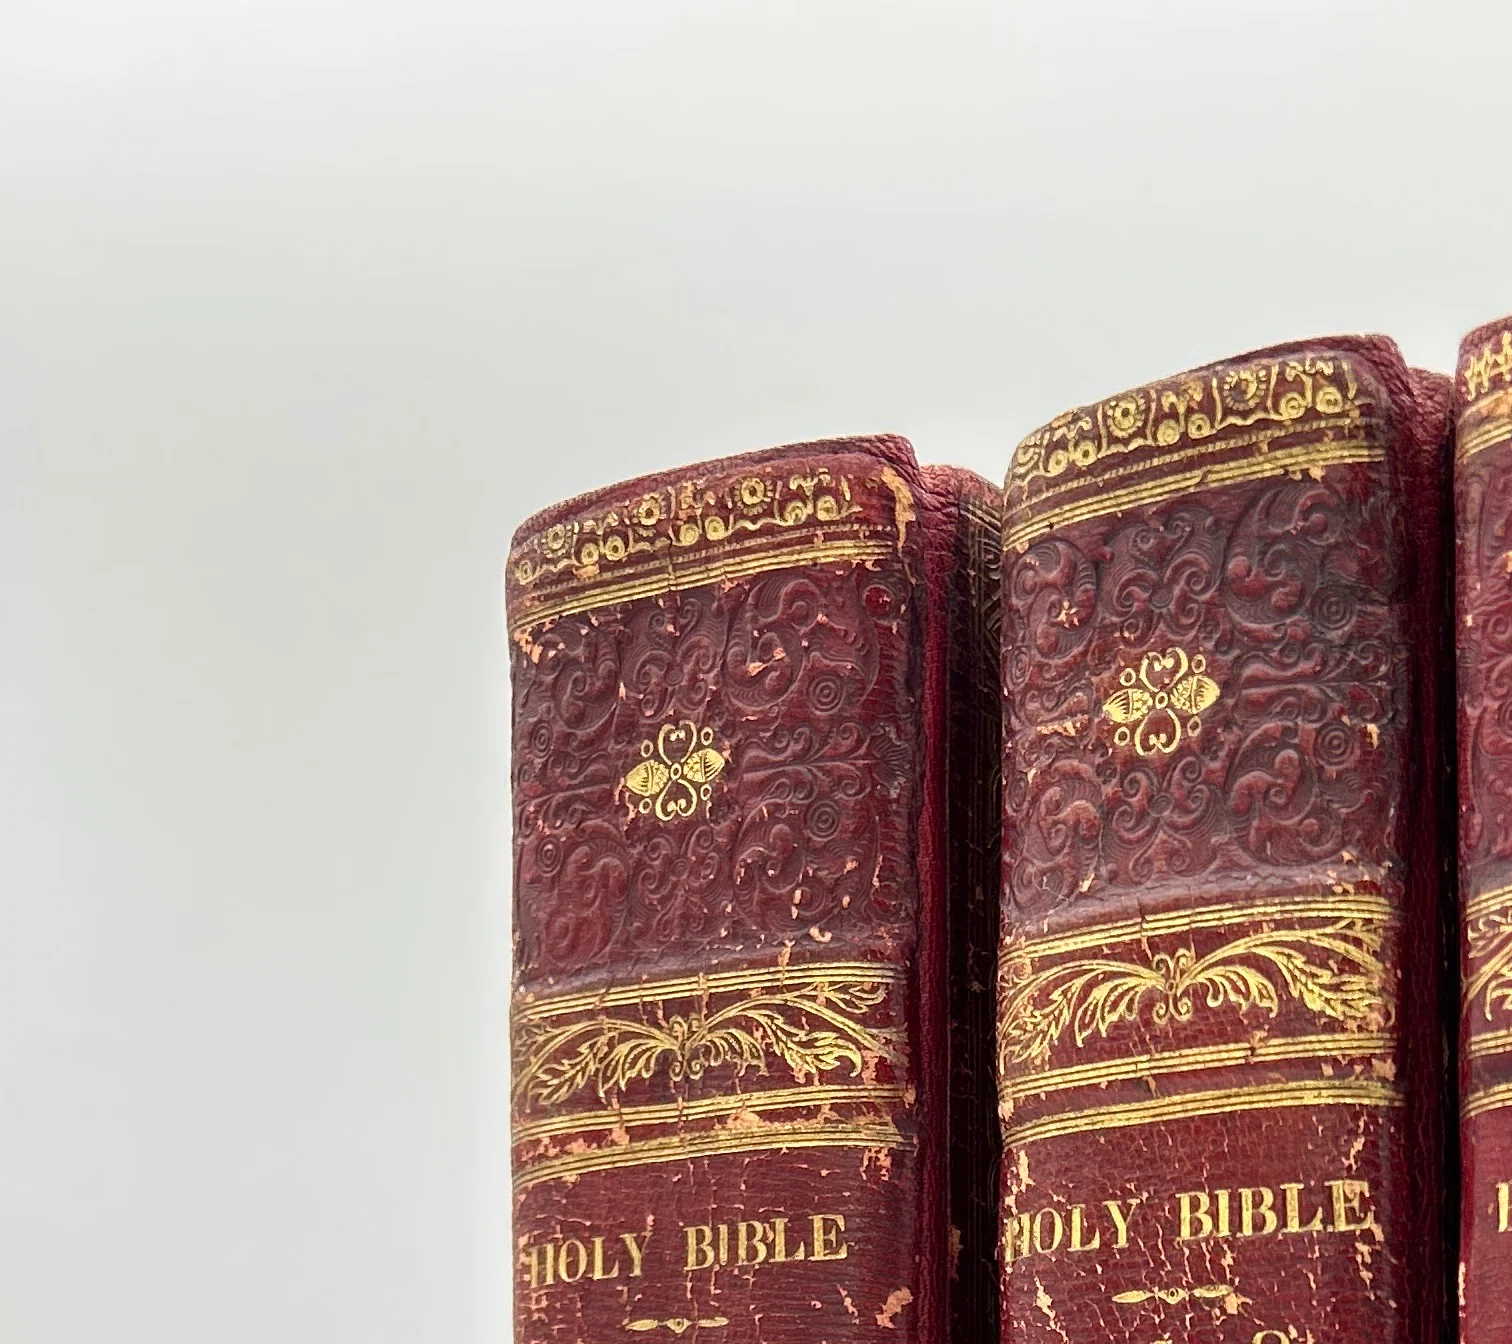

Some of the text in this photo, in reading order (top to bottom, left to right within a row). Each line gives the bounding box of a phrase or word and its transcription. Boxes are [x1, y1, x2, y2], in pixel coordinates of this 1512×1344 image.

[527, 1213, 848, 1288] HOLY BIBLE
[1004, 1179, 1375, 1264] HOLY BIBLE
